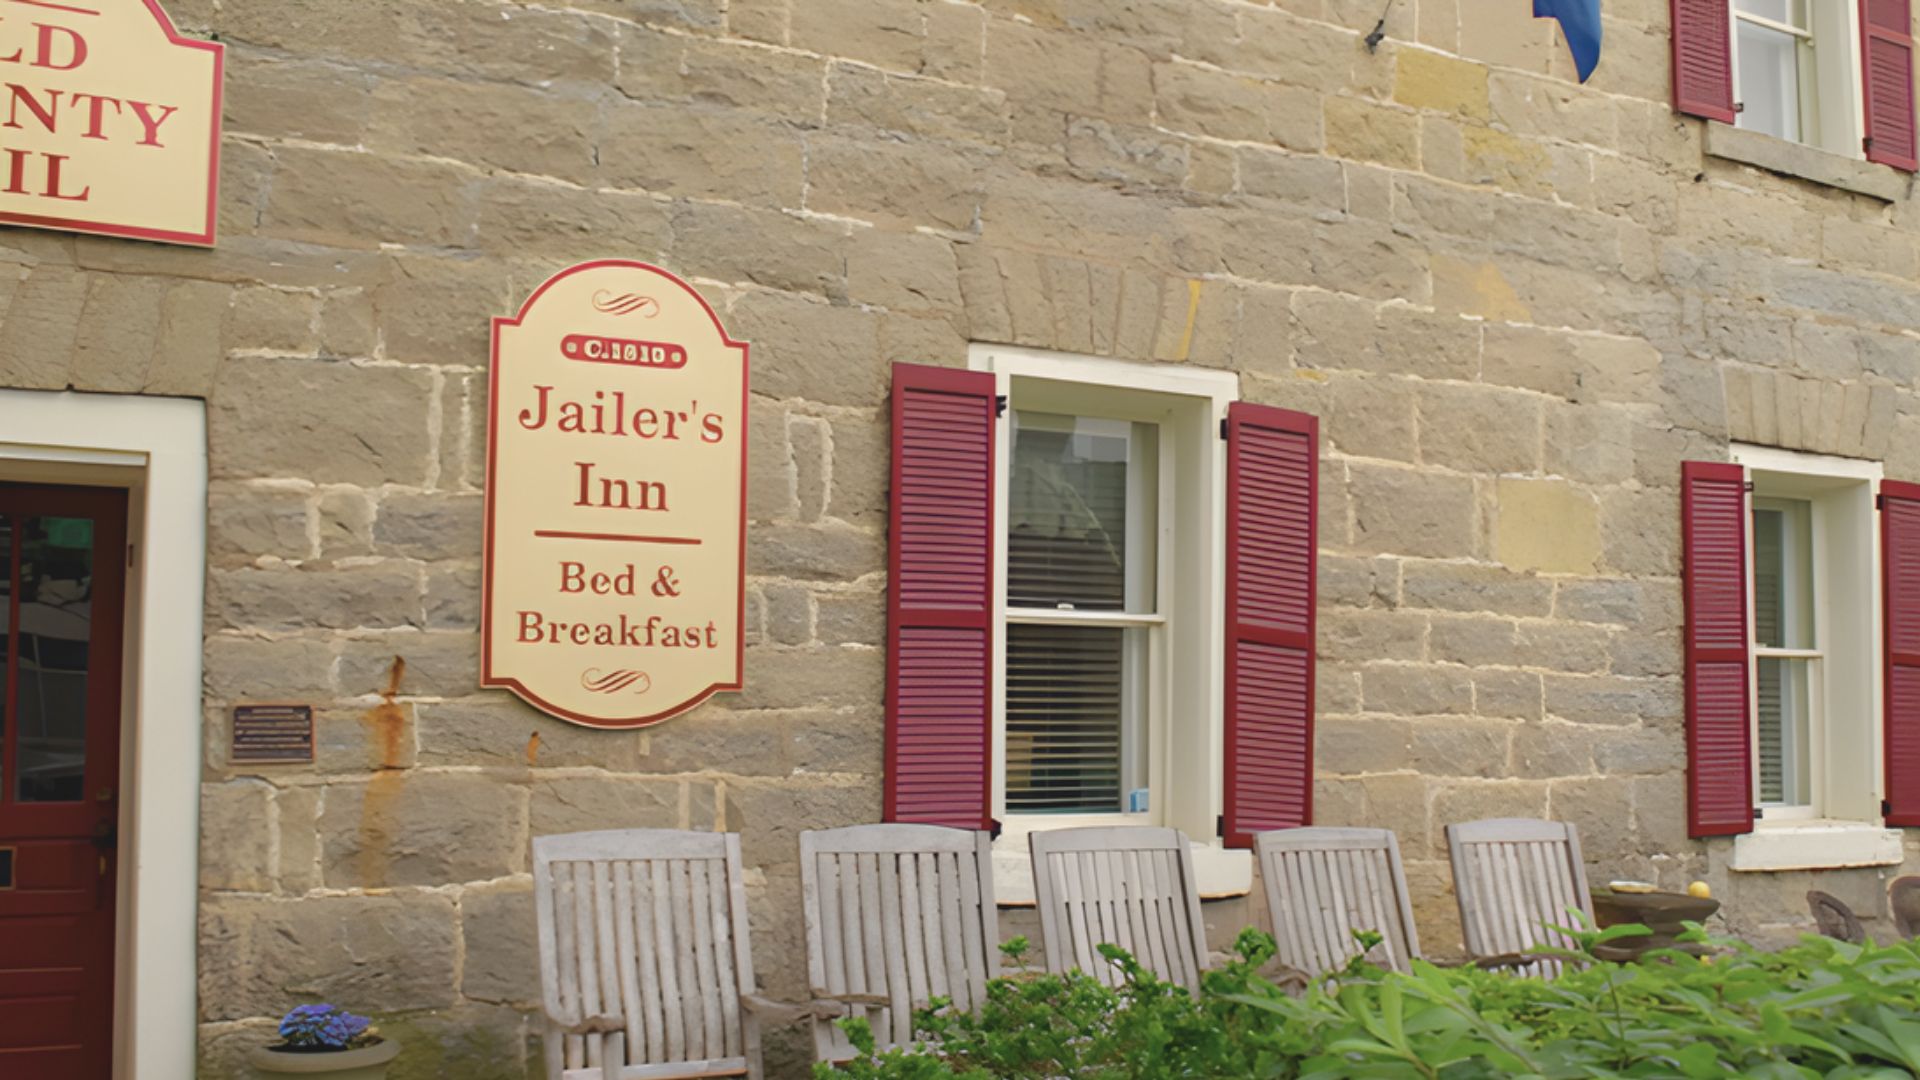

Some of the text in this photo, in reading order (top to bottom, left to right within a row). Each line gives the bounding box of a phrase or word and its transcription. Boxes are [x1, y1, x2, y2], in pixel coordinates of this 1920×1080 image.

[2, 82, 179, 148] NTY
[1, 147, 90, 202] IL
[518, 385, 724, 443] Jailer's
[574, 461, 669, 511] Inn
[559, 561, 681, 598] Bed &
[516, 611, 718, 649] Breakfast
